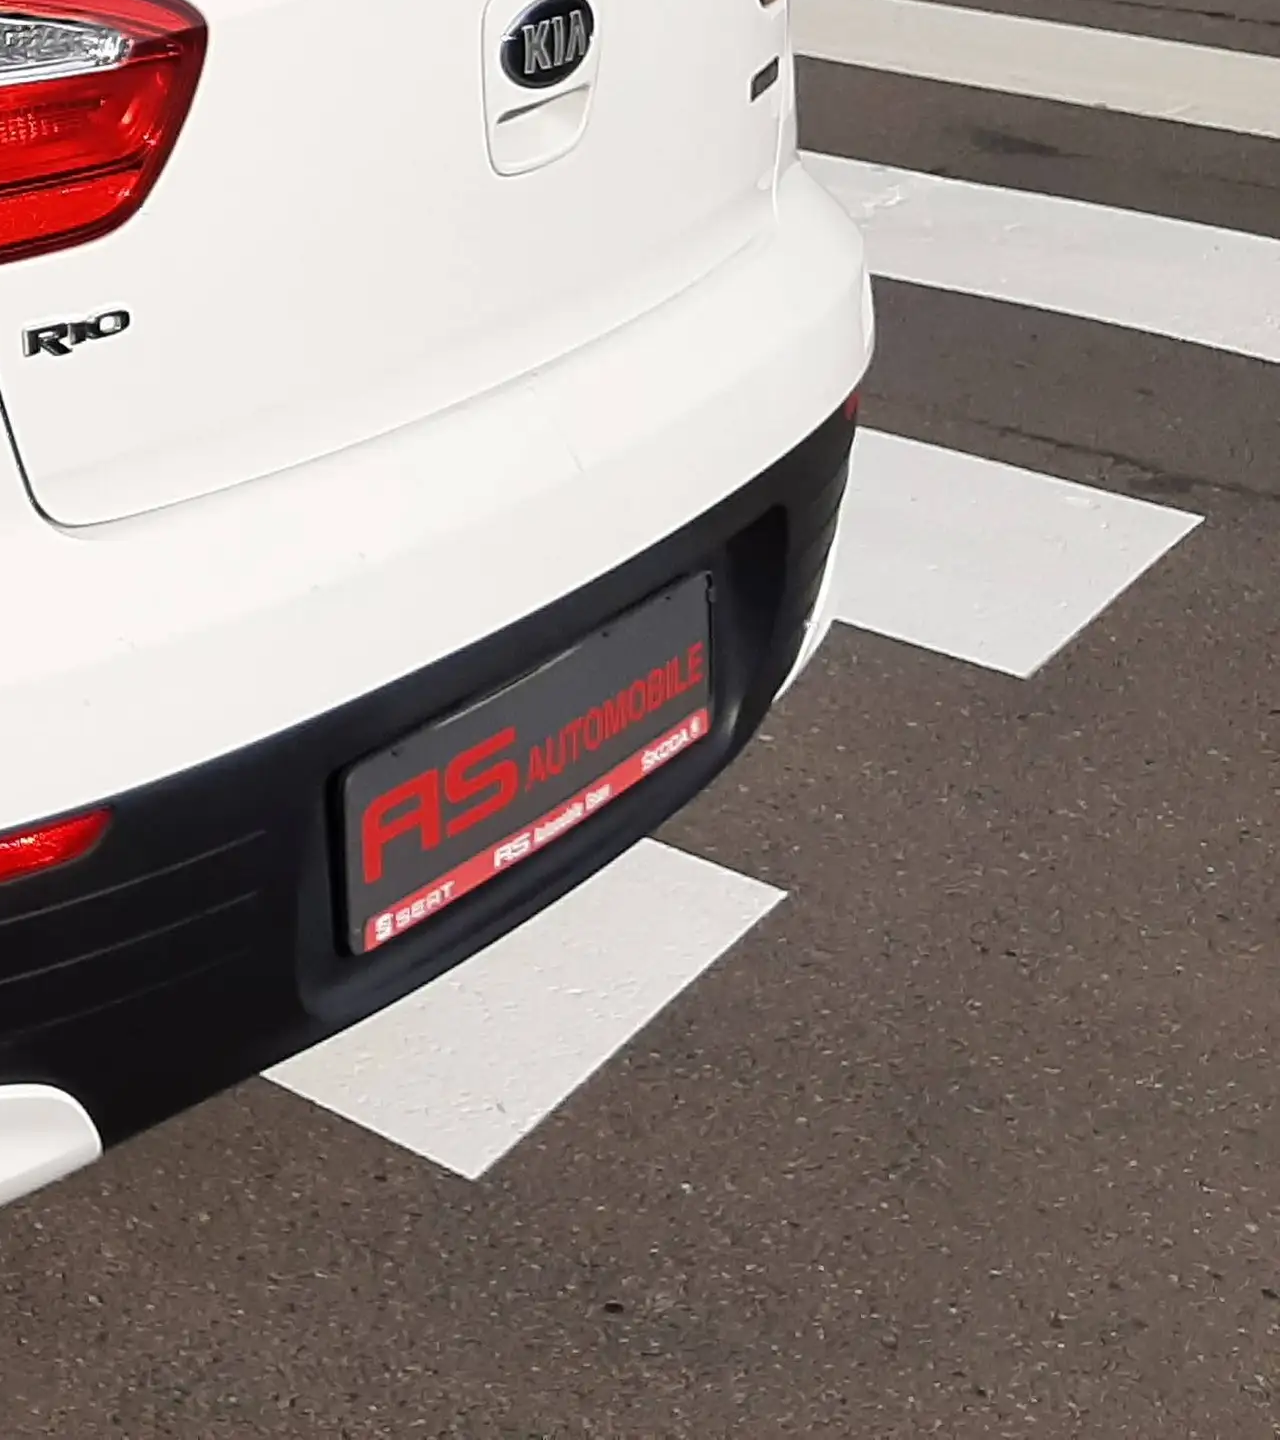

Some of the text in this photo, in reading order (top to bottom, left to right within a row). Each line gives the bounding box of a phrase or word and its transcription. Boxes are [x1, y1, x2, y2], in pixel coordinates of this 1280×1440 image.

[521, 9, 587, 75] KIA
[360, 726, 518, 885] AS
[525, 641, 705, 792] AUTOMOBILE
[395, 880, 456, 928] SEAT
